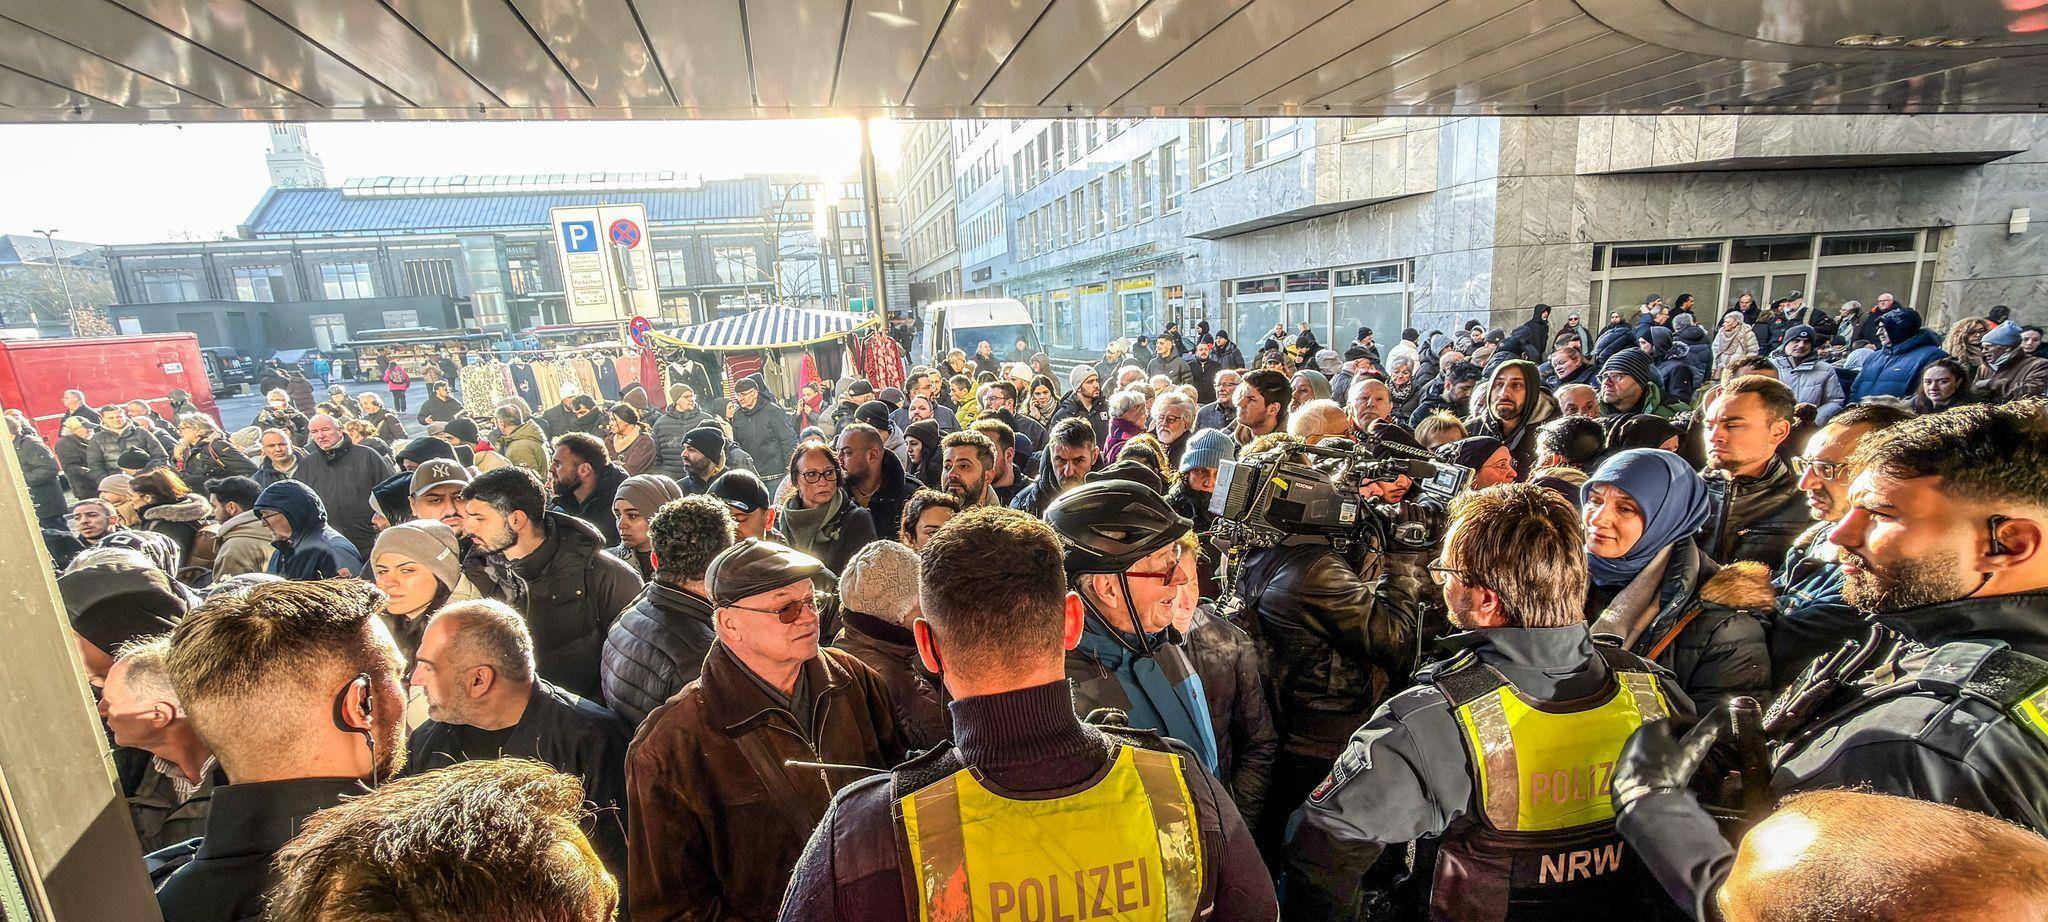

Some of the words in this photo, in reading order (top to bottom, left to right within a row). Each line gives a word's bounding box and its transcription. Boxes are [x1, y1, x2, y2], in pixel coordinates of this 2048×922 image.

[568, 224, 589, 250] P
[432, 463, 450, 478] NY
[1531, 761, 1614, 806] POLIZ
[1539, 841, 1624, 884] NRW
[989, 857, 1150, 922] POLIZEI
